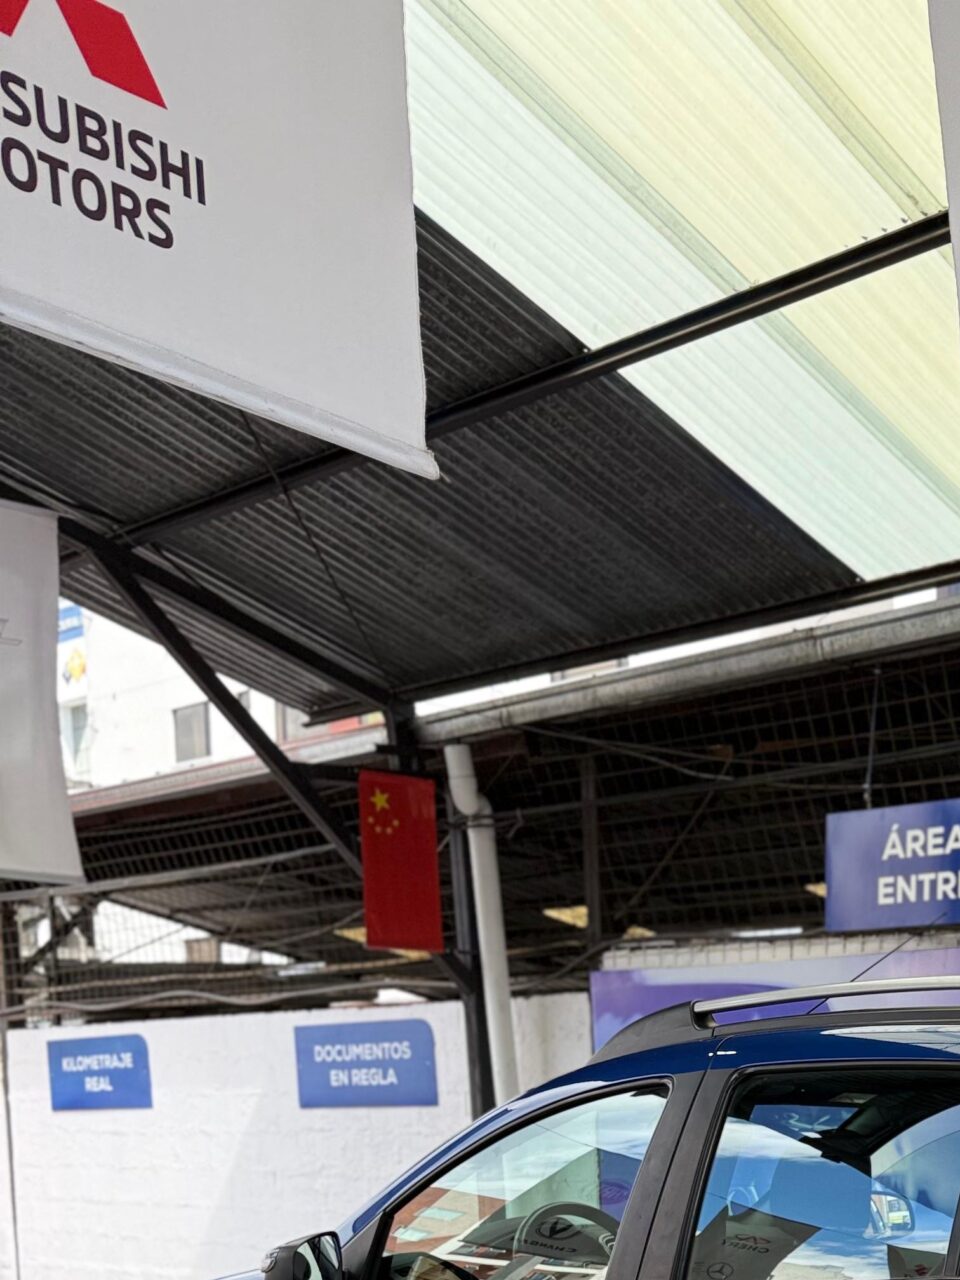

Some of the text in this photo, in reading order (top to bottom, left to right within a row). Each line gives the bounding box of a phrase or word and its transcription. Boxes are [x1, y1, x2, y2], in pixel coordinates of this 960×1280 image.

[0, 70, 207, 206] SUBISHI
[1, 137, 174, 249] OTORS
[314, 1040, 411, 1062] DOCUMENTOS
[62, 1052, 133, 1072] KILOMETRAJE
[84, 1076, 113, 1092] REAL
[330, 1067, 398, 1087] EN REGLA
